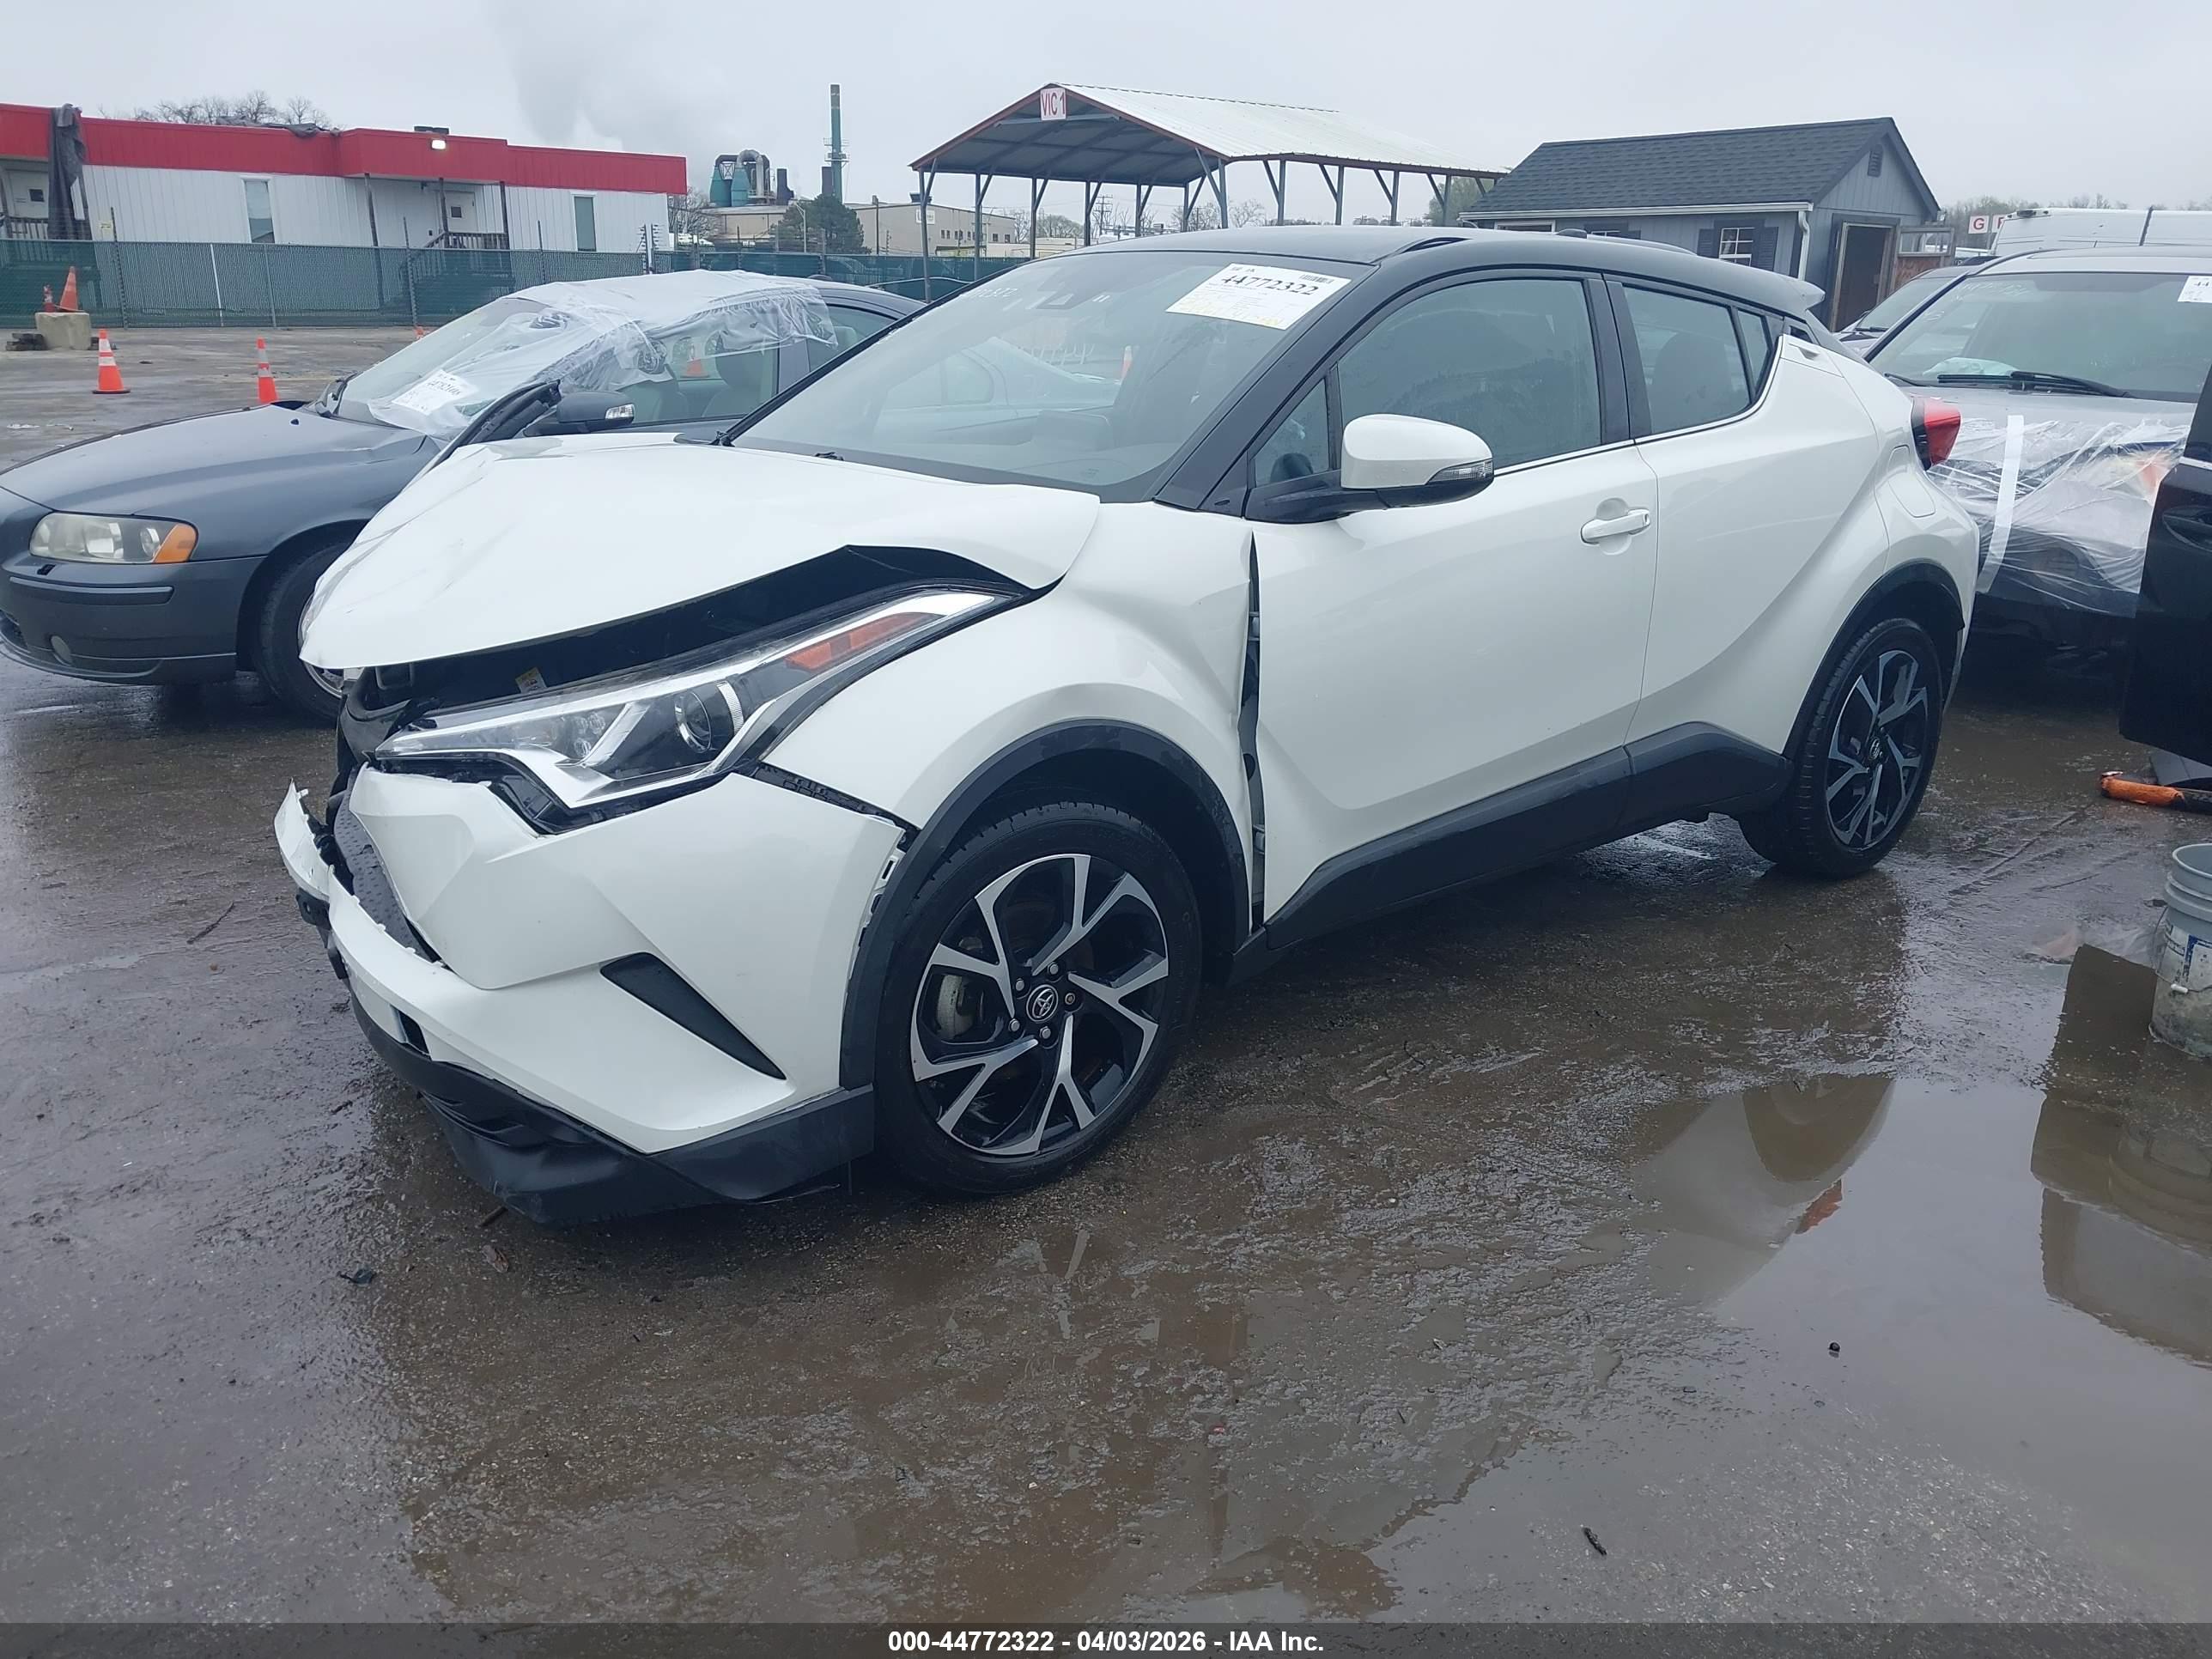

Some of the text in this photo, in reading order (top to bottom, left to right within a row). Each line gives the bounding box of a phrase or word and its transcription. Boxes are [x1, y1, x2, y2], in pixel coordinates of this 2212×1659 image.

[1041, 91, 1065, 116] VIC 1
[1973, 217, 1984, 230] G
[1221, 274, 1319, 295] 44772322
